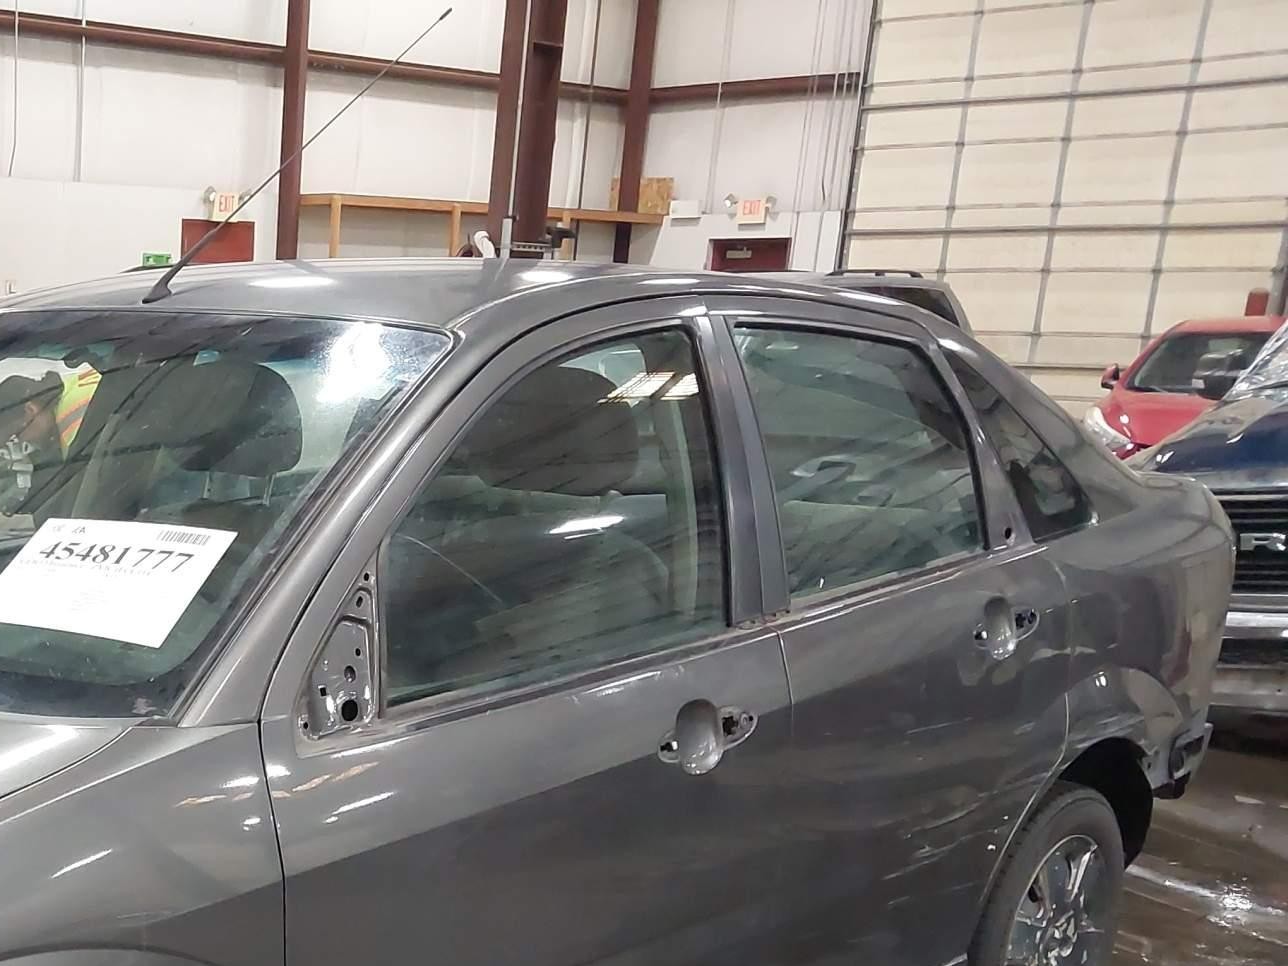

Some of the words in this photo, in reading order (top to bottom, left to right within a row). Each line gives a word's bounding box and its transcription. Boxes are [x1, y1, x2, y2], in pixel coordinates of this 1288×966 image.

[219, 195, 235, 212] EXIT
[743, 200, 761, 215] EXIT
[39, 541, 194, 573] 45481777
